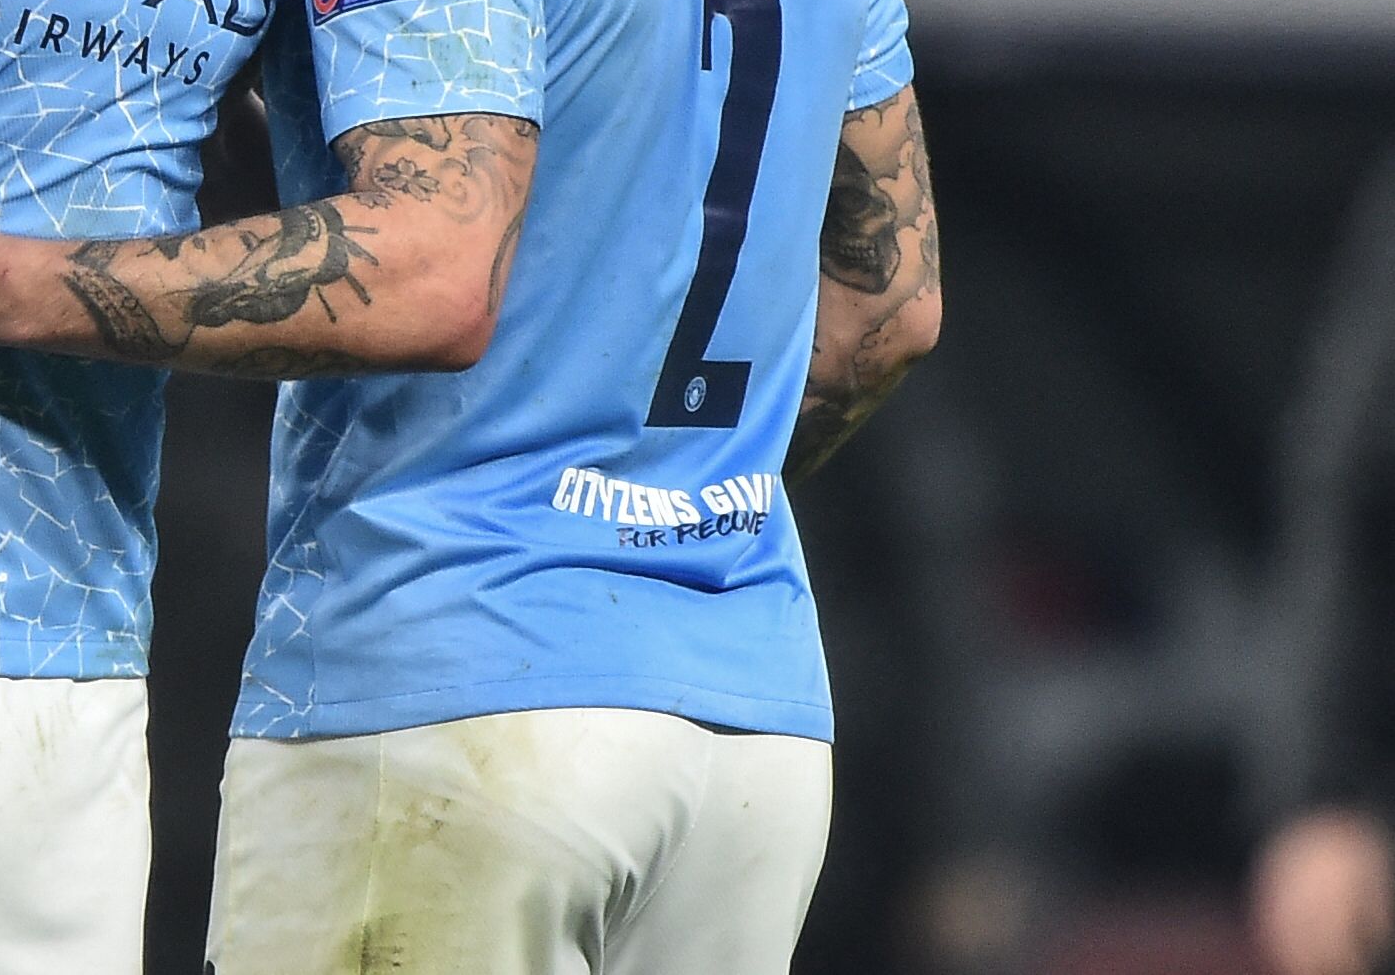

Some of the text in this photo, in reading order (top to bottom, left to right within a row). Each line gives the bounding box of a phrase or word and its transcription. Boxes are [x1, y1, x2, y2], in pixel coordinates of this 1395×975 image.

[552, 467, 774, 527] CITYZENS GIVI
[617, 527, 668, 548] FOR
